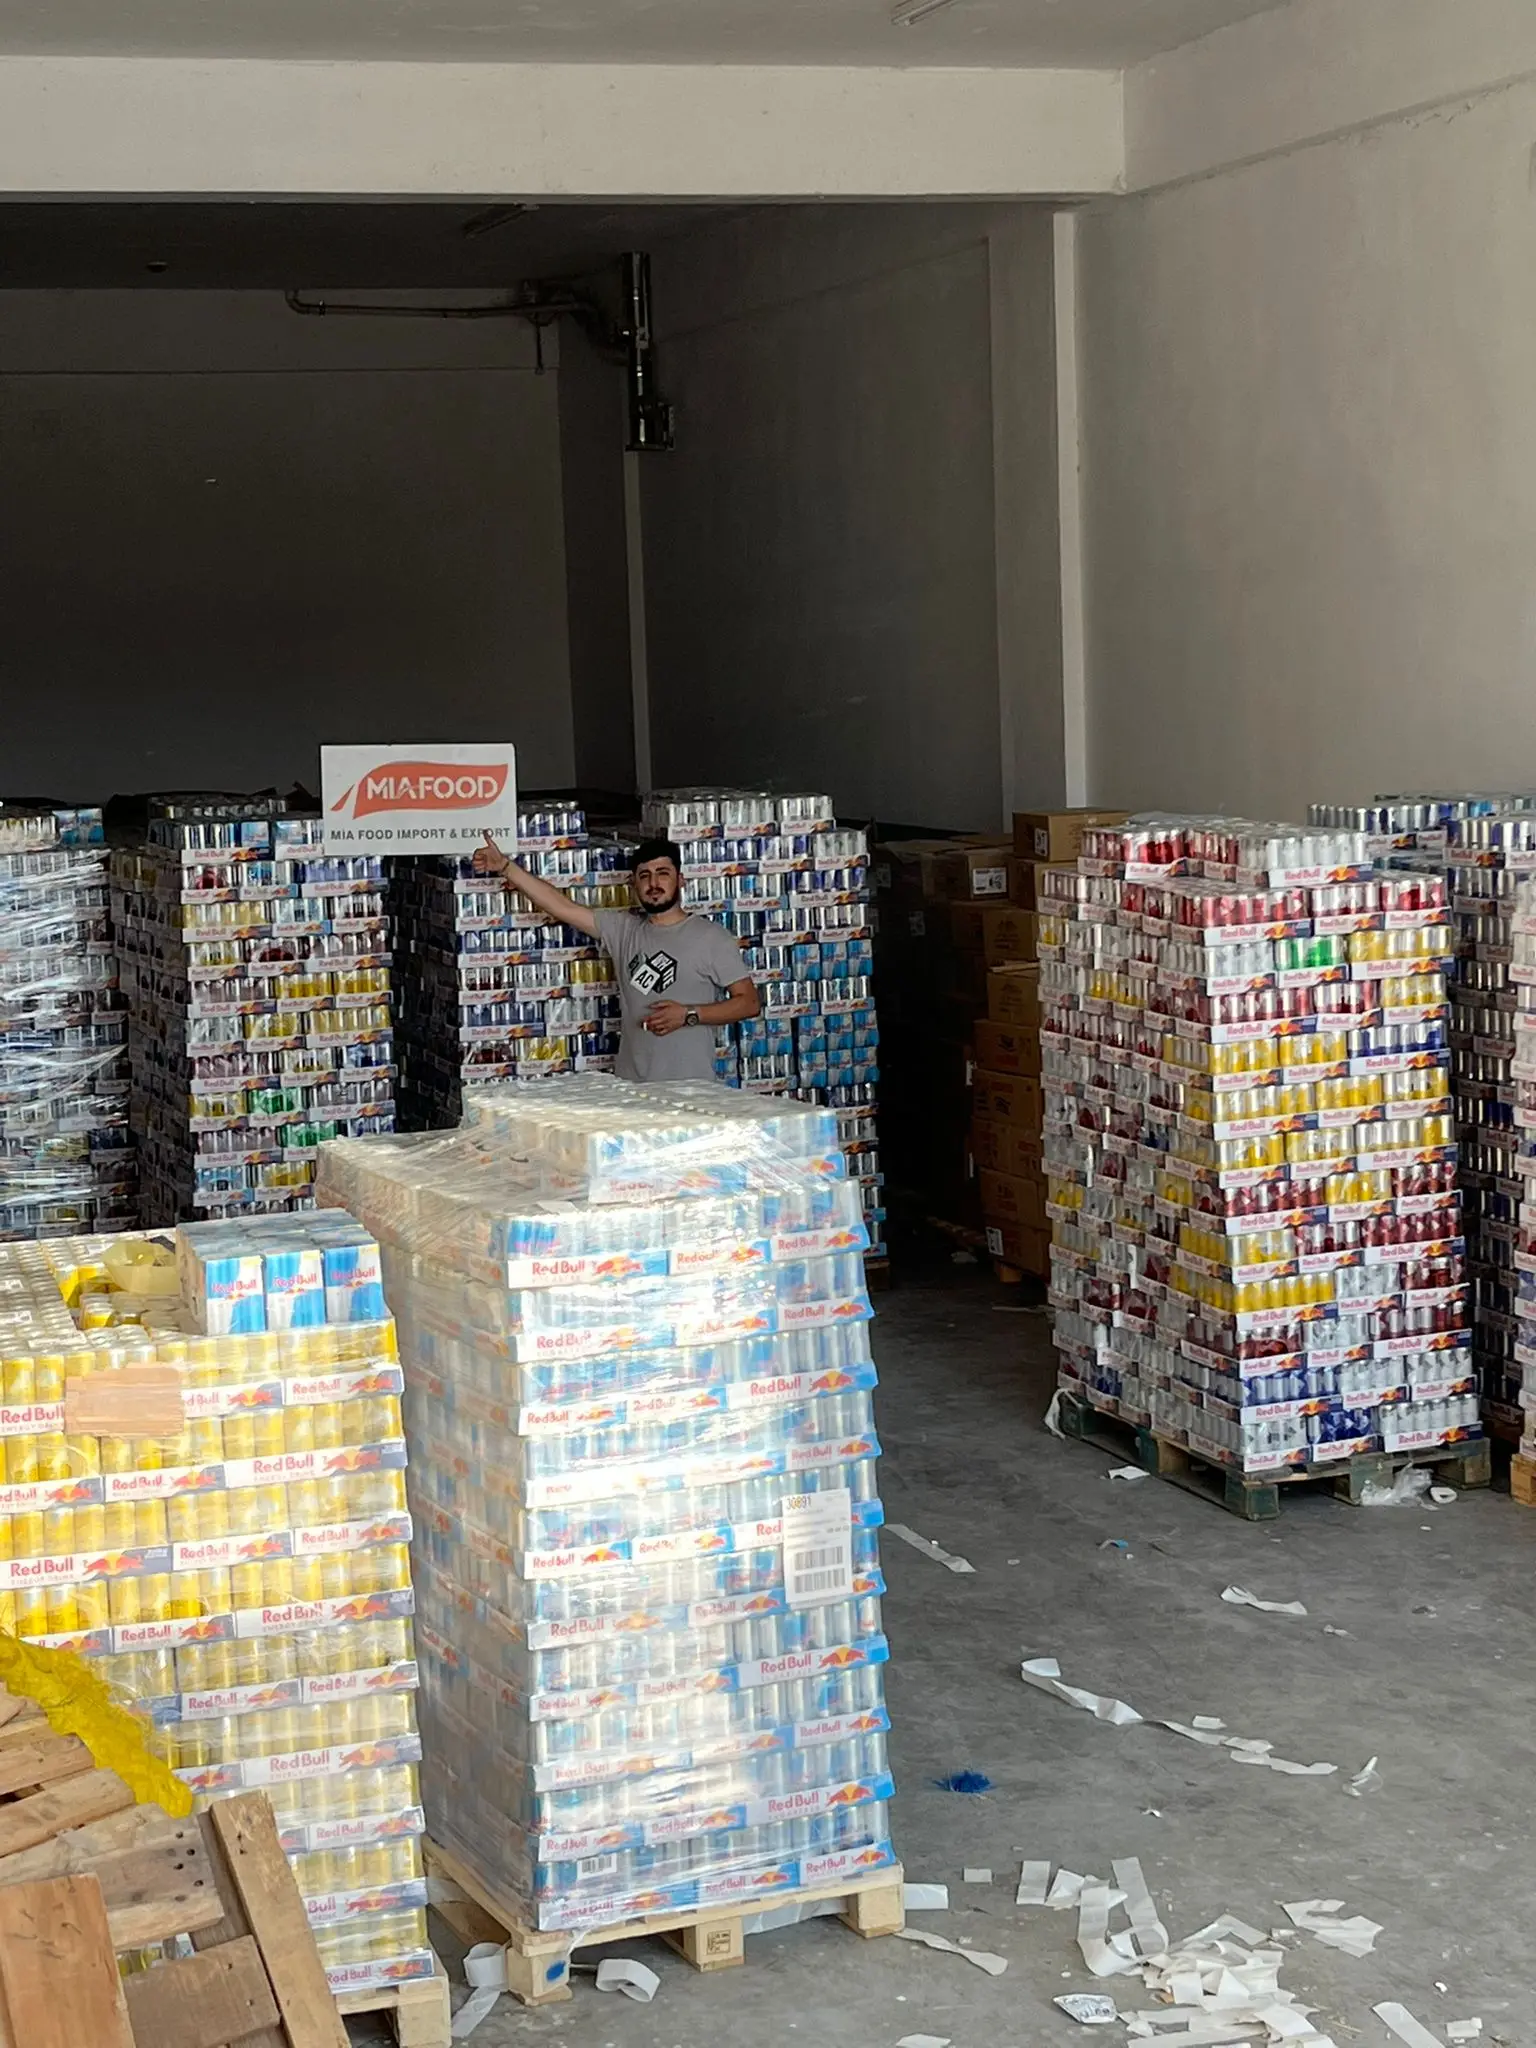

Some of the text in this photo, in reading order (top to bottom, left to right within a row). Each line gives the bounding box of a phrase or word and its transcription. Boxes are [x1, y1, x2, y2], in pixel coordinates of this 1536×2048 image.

[367, 776, 498, 800] MIAFOOD
[331, 828, 510, 840] MIA FOOD IMPORT & EXPORT
[778, 1235, 818, 1250] Red Bull
[532, 1260, 585, 1275] Red Bull
[784, 1305, 824, 1320] Red Bull
[751, 1376, 801, 1396] Red Bull
[1, 1406, 64, 1423] Red Bull
[253, 1455, 314, 1473] Red Bull
[112, 1478, 136, 1490] Red
[14, 1488, 36, 1499] Bull
[302, 1528, 349, 1543] Red Bull
[756, 1520, 782, 1535] Red
[180, 1546, 204, 1559] Red
[207, 1543, 229, 1556] Bull
[11, 1557, 73, 1577] Red Bull
[262, 1607, 293, 1624] Red
[122, 1625, 171, 1641] Red Bull
[551, 1618, 605, 1637] Red Bull
[761, 1654, 812, 1674] Red Bull
[309, 1677, 357, 1692] Red Bull
[189, 1691, 237, 1709] Red Bull
[270, 1751, 330, 1773] Red Bull
[768, 1792, 819, 1812] Red Bull
[317, 1822, 364, 1840] Red Bull
[308, 1897, 336, 1914] Bull
